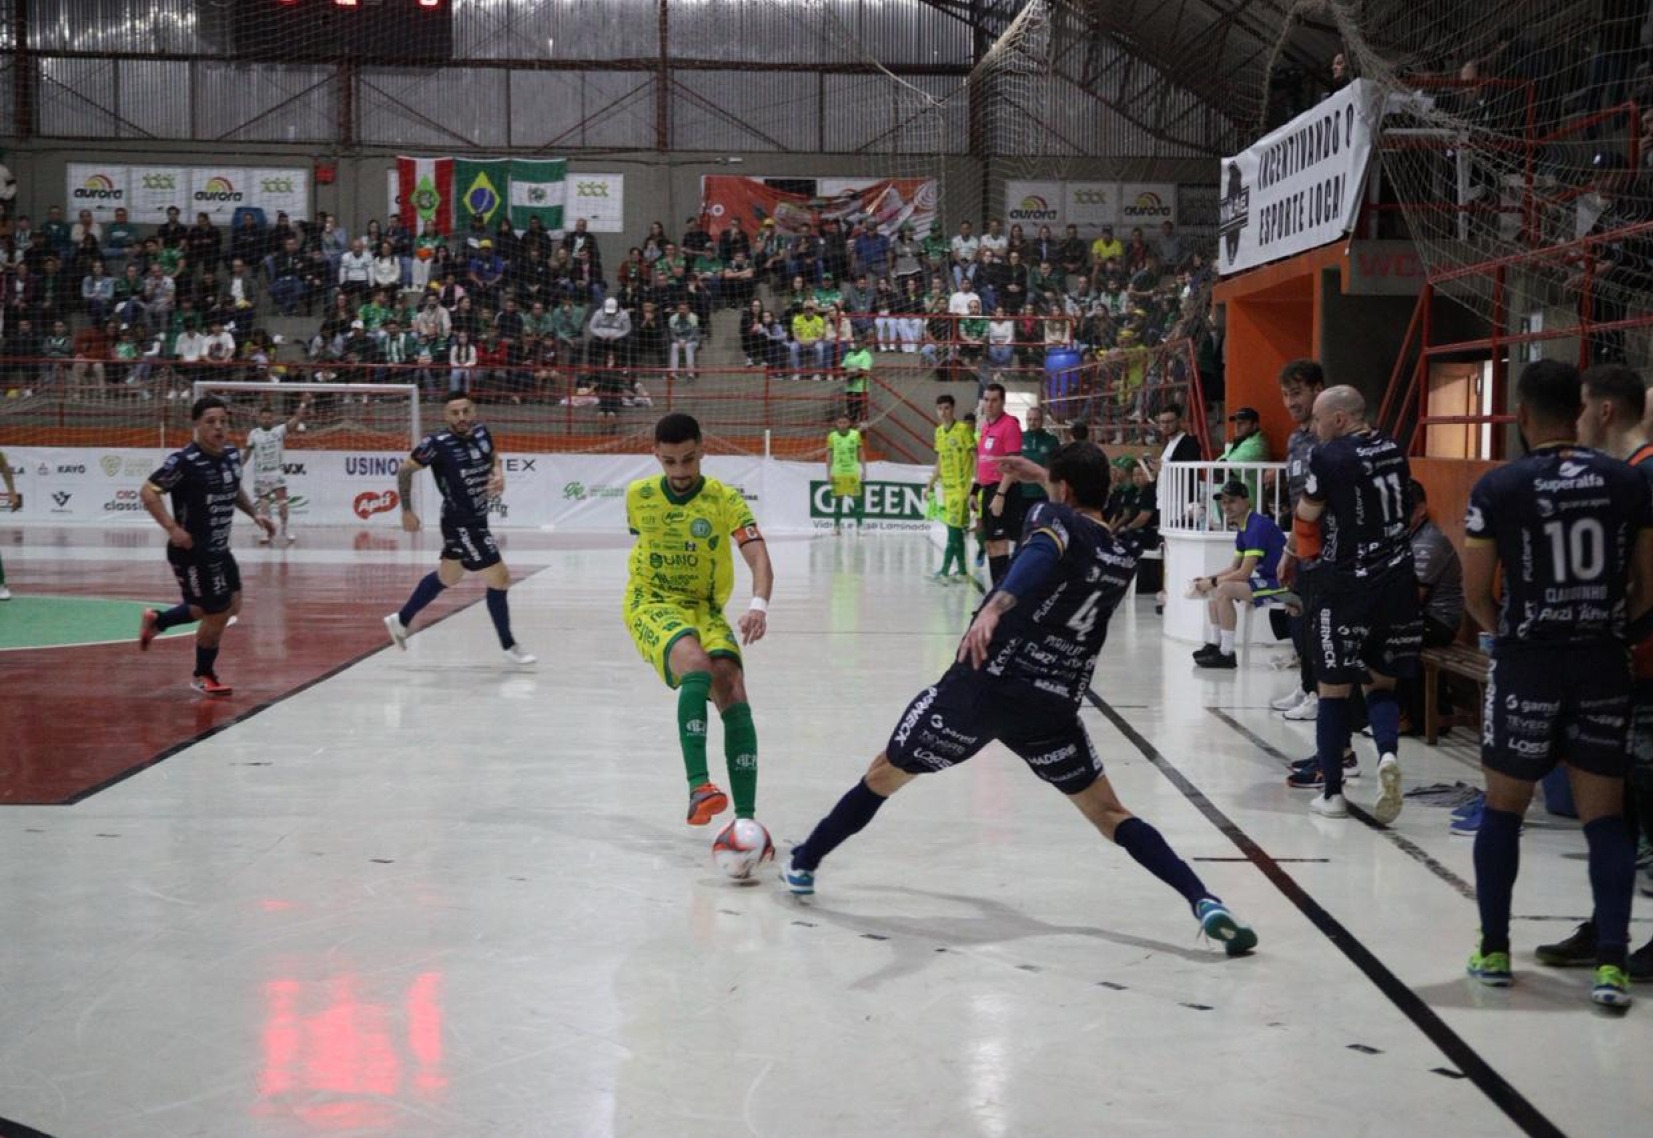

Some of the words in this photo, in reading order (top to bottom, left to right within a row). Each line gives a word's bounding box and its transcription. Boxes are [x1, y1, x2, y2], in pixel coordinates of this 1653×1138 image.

[1257, 110, 1341, 190] INCENTIVANDO
[1345, 103, 1354, 149] O
[74, 187, 123, 200] aurora
[194, 189, 243, 202] aurora
[1124, 204, 1171, 217] aurora
[1009, 208, 1058, 220] aurora
[1258, 191, 1304, 247] ESPORTE
[1373, 472, 1404, 523] 11
[1534, 473, 1604, 493] Superalfa
[880, 521, 931, 532] Laminado
[1544, 518, 1605, 583] 10
[1066, 590, 1103, 641] 4
[1320, 608, 1337, 669] BERNECK
